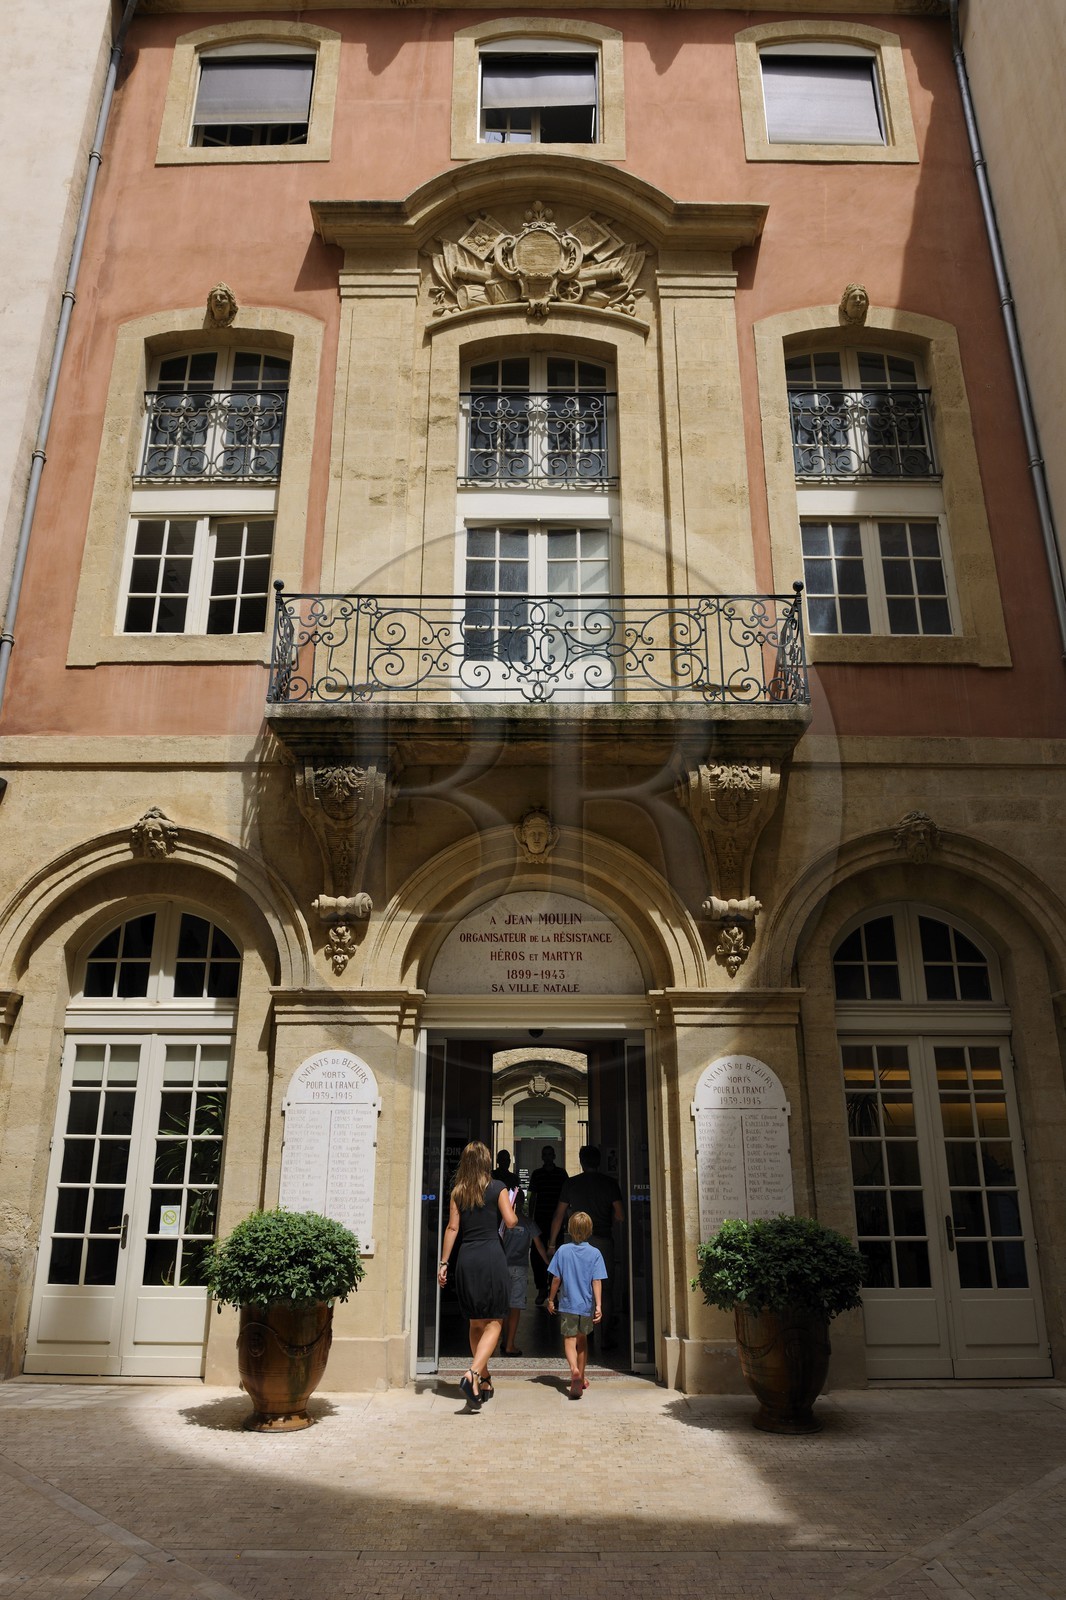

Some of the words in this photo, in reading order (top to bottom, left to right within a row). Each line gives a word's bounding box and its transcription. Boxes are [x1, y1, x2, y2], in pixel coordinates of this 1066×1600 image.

[489, 916, 497, 925] A
[504, 914, 533, 925] JEAN
[538, 913, 582, 925] MOULIN
[459, 932, 527, 943] ORGANISATEUR
[529, 935, 540, 943] DE
[541, 935, 551, 943] LA
[553, 931, 613, 943] RÉSISTANCE
[490, 948, 525, 961] HÉROS
[529, 953, 539, 961] ET
[542, 951, 583, 961] MARTYR
[491, 983, 504, 993] SA
[508, 983, 539, 993] VILLE
[543, 983, 580, 993] NATALE
[298, 1057, 329, 1084] ENFANTS
[321, 1071, 346, 1079] MORTS
[727, 1076, 752, 1084] MORTS
[306, 1081, 324, 1090] POUR
[325, 1081, 333, 1090] LA
[335, 1081, 360, 1090] FRANCE
[713, 1086, 731, 1095] POUR
[732, 1086, 740, 1095] LA
[742, 1086, 767, 1095] FRANCE
